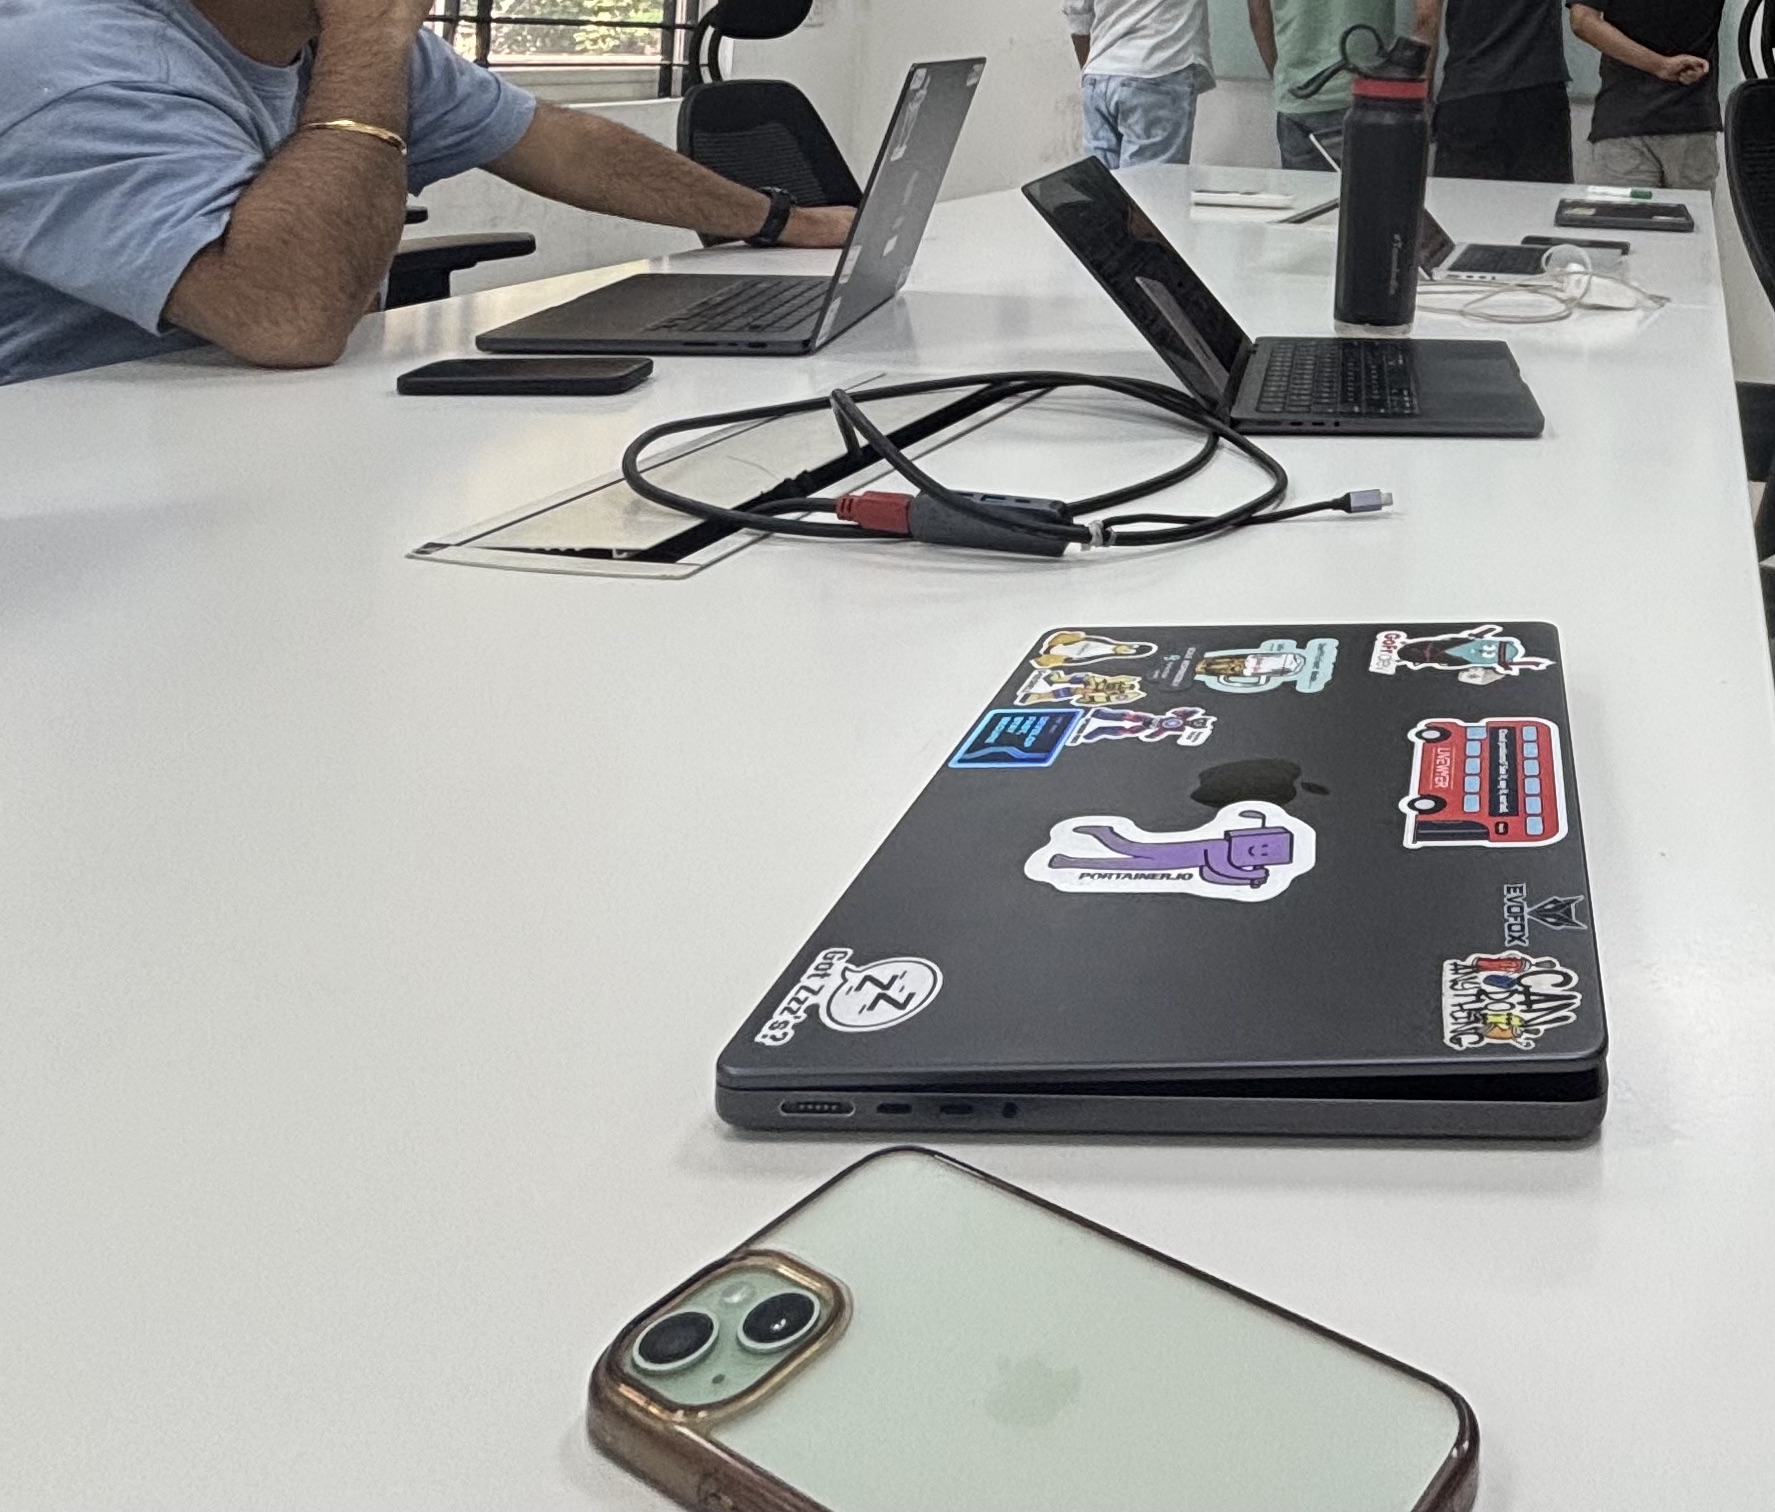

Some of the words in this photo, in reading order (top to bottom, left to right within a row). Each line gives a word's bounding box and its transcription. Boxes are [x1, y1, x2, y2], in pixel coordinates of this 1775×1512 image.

[1079, 872, 1193, 880] PORTAINER.IO
[1505, 885, 1525, 945] EVOFOX
[807, 950, 848, 980] Got
[1449, 962, 1484, 1047] ANYTHING
[1477, 989, 1517, 1012] DO
[1516, 970, 1579, 1028] CAN
